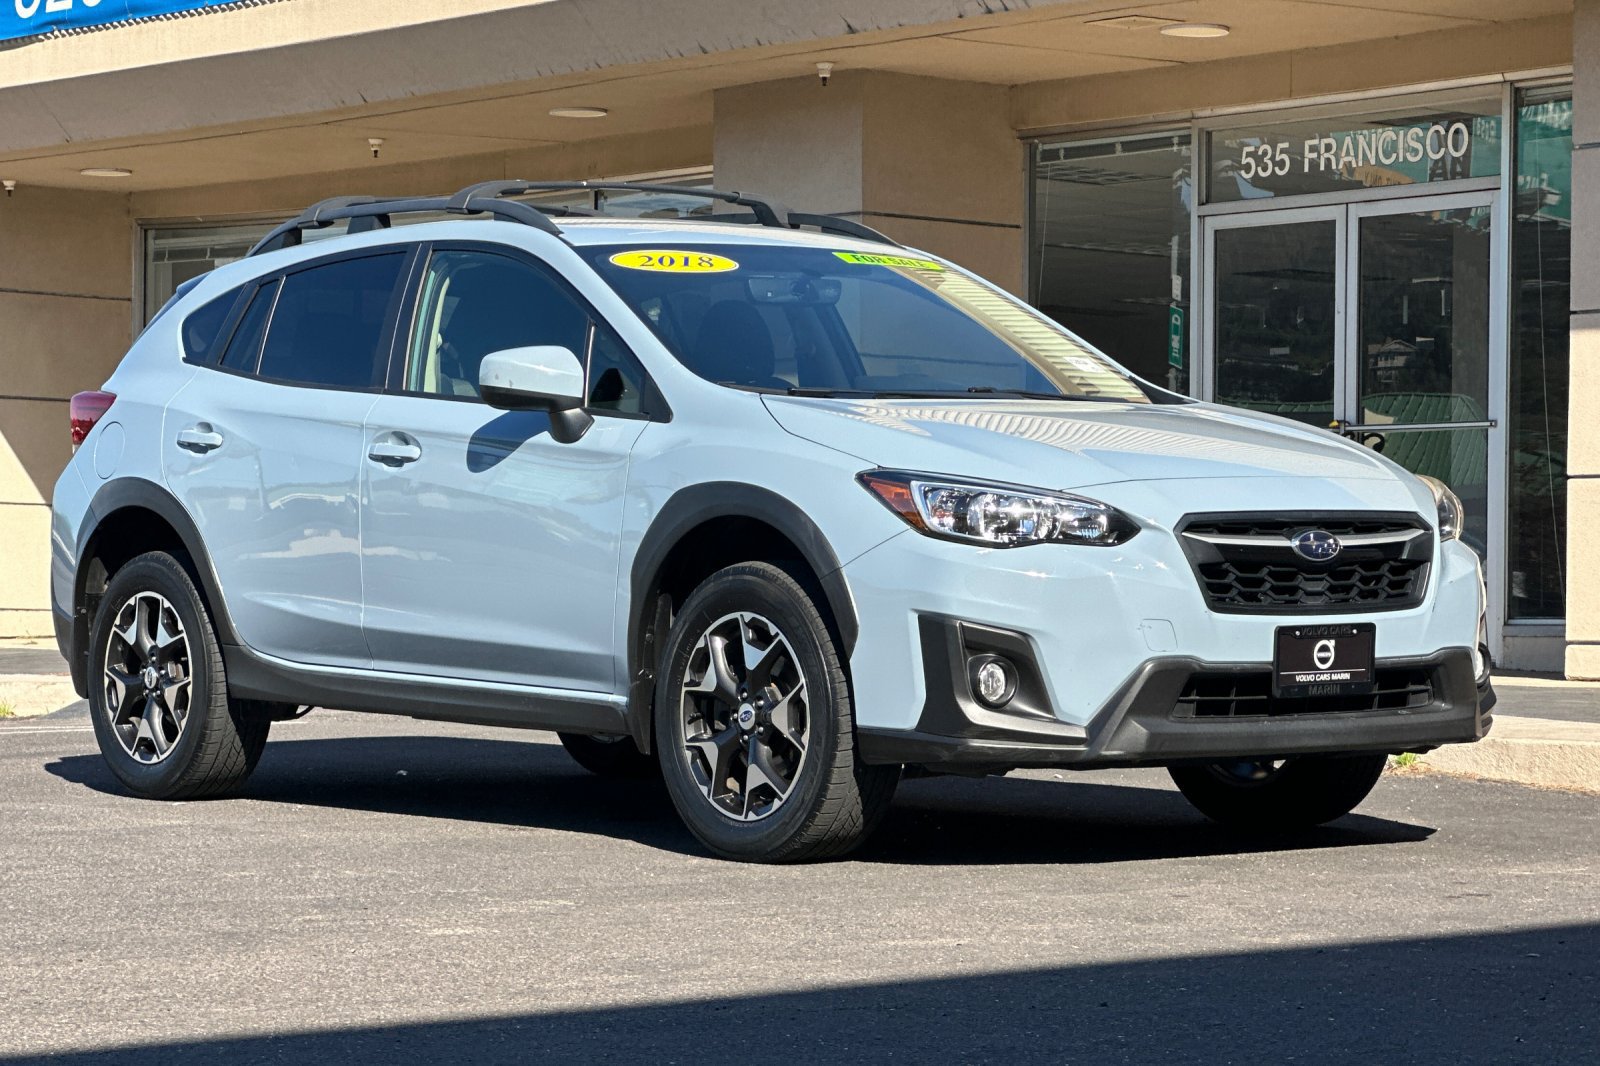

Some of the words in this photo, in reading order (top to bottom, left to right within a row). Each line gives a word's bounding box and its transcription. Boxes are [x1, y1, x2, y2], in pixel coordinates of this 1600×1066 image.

[1240, 141, 1290, 179] 535
[1304, 122, 1469, 173] FRANCISCO
[638, 255, 714, 269] 2018
[851, 254, 886, 264] FOR
[888, 257, 926, 268] SALE
[1301, 627, 1328, 636] VOLVO
[1329, 625, 1352, 635] CARS
[1295, 674, 1315, 682] VOLVO
[1316, 673, 1331, 681] CARS
[1331, 672, 1351, 680] MARIN
[1308, 684, 1340, 695] MARIN
